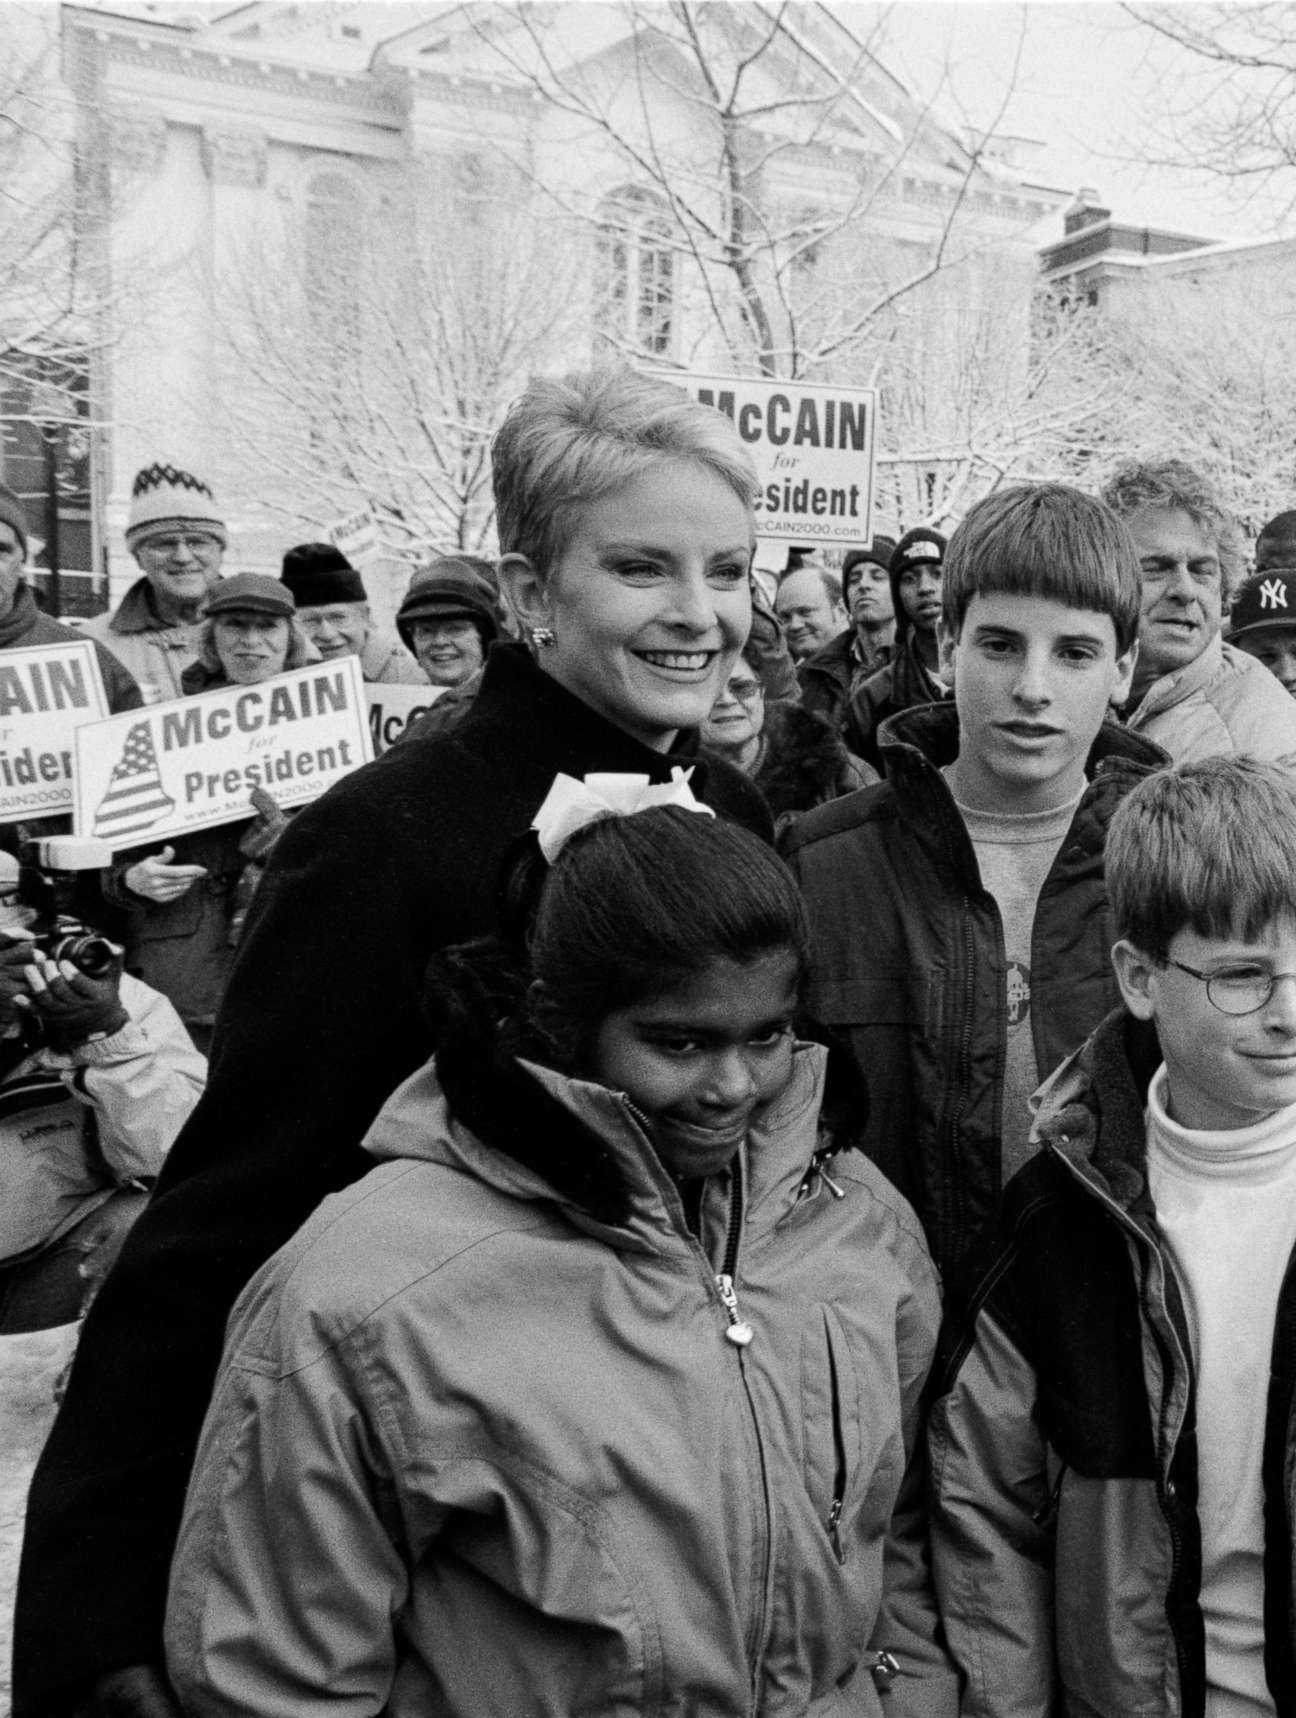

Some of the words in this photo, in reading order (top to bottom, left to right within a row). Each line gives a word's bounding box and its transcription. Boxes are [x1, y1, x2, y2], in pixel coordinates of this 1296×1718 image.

[770, 451, 801, 471] for
[1259, 578, 1288, 609] NY
[162, 673, 348, 752] McCAIN
[184, 739, 353, 803] President
